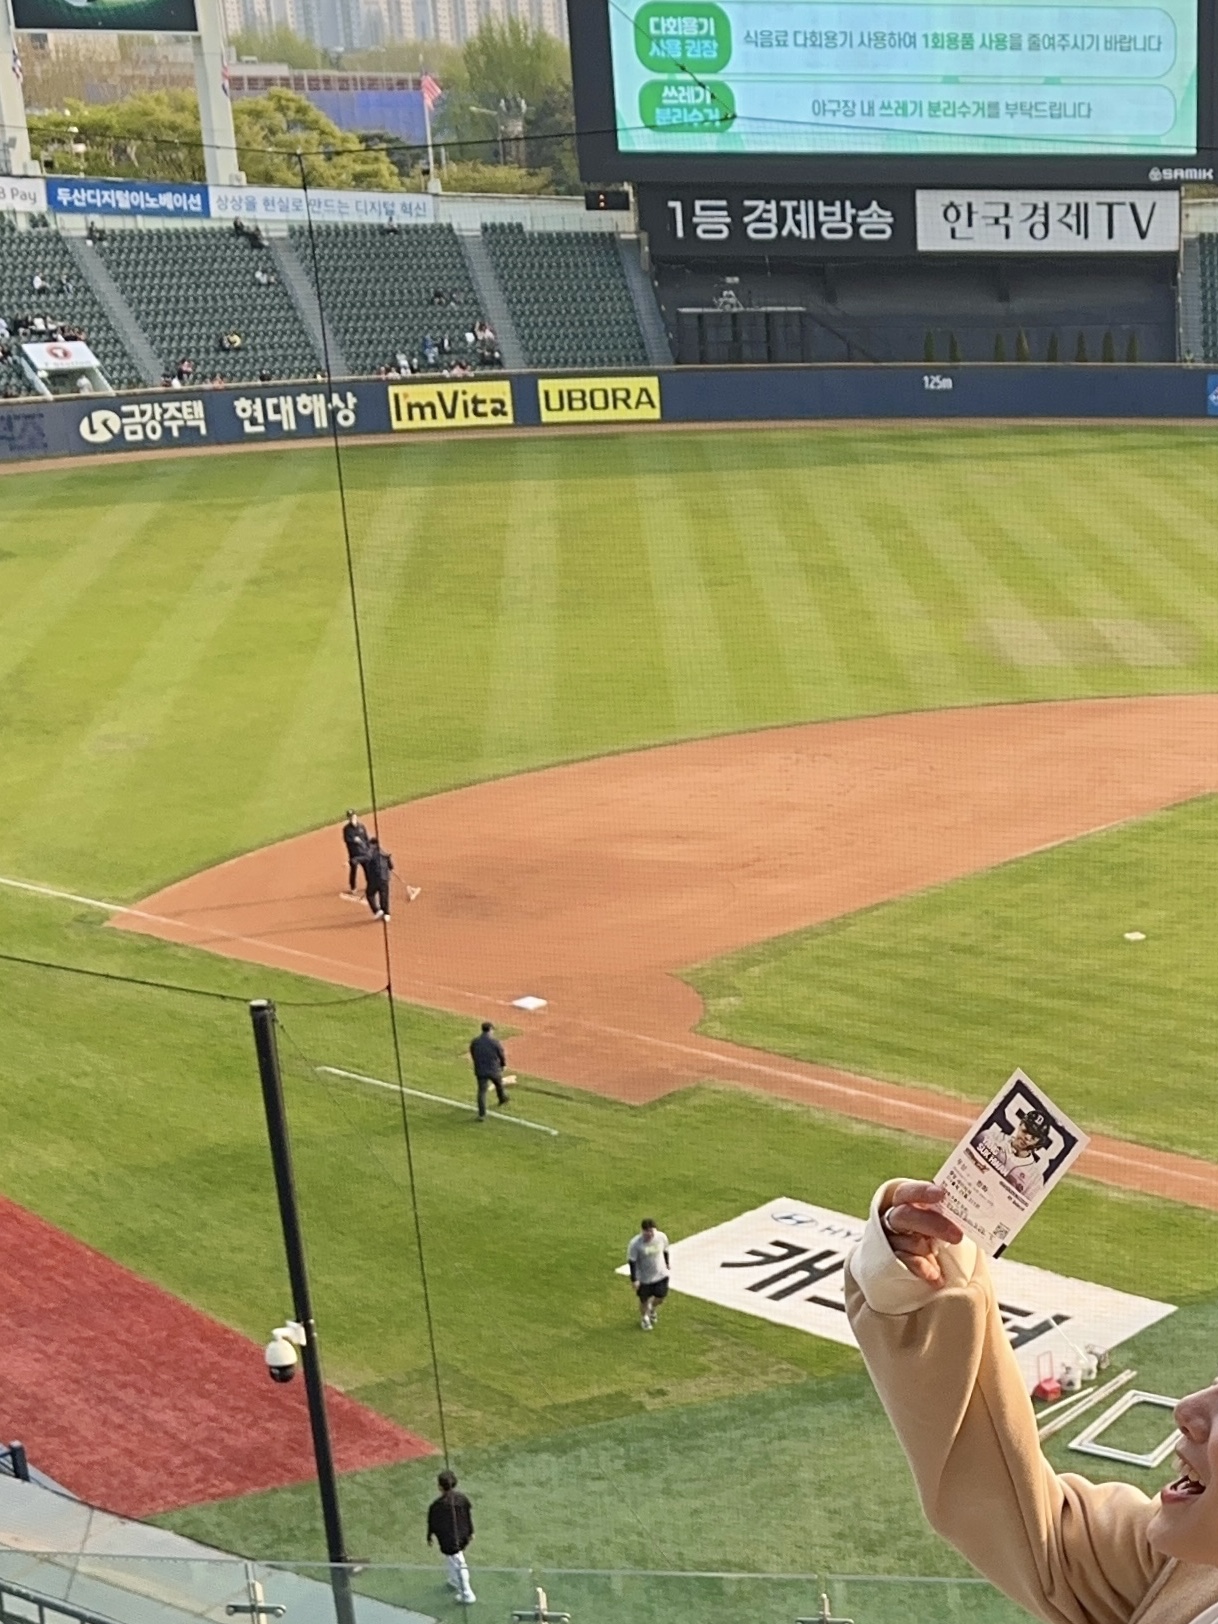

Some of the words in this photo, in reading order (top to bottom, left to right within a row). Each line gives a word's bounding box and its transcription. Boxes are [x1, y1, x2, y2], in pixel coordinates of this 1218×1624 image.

[650, 16, 715, 36] 다회용기
[743, 30, 789, 48] 식음료
[793, 31, 854, 49] 다회용기
[857, 31, 917, 49] 사용하여
[922, 32, 975, 51] 1회용품
[979, 32, 1023, 51] 사용을
[1027, 33, 1099, 52] 줄여주시기
[1104, 34, 1162, 52] 바랍니다
[661, 85, 712, 105] 쓰레기
[655, 106, 720, 127] 분리수거
[811, 99, 856, 118] 야구장
[860, 99, 875, 118] 내
[879, 99, 923, 119] 쓰레기
[928, 100, 1000, 119] 분리수거를
[1004, 101, 1092, 119] 부탁드립니다
[1161, 168, 1214, 181] SAMIK
[12, 189, 37, 204] Pay
[57, 187, 202, 211] 두산디지털이노베이션
[216, 195, 257, 212] 상상을
[263, 197, 303, 213] 현실로
[308, 199, 349, 215] 만드는
[355, 201, 395, 218] 디지털
[401, 201, 427, 217] 혁신
[666, 200, 732, 241] 1등
[742, 200, 895, 241] 경제방송
[940, 200, 1158, 241] 한국경제TV
[922, 375, 953, 391] 125m
[544, 386, 657, 413] UBORA
[121, 400, 207, 441] 금강주택
[233, 391, 358, 433] 현대해상
